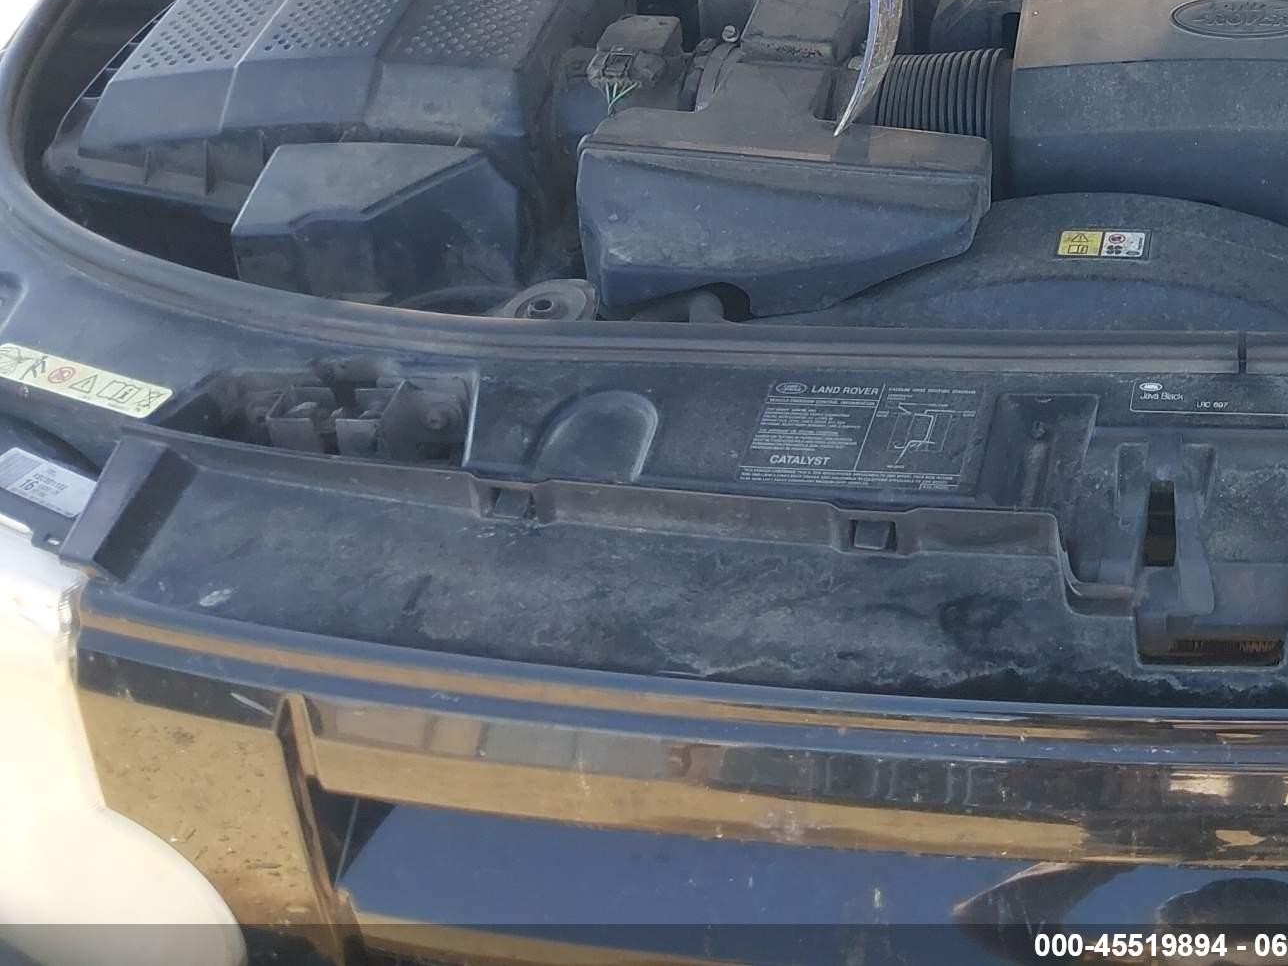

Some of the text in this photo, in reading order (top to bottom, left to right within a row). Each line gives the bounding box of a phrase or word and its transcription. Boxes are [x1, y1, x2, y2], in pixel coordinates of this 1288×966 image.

[811, 385, 841, 395] LAND
[843, 386, 879, 396] ROVER
[1140, 392, 1184, 401] Java Black
[769, 454, 831, 466] CATALYST
[20, 478, 39, 491] 16
